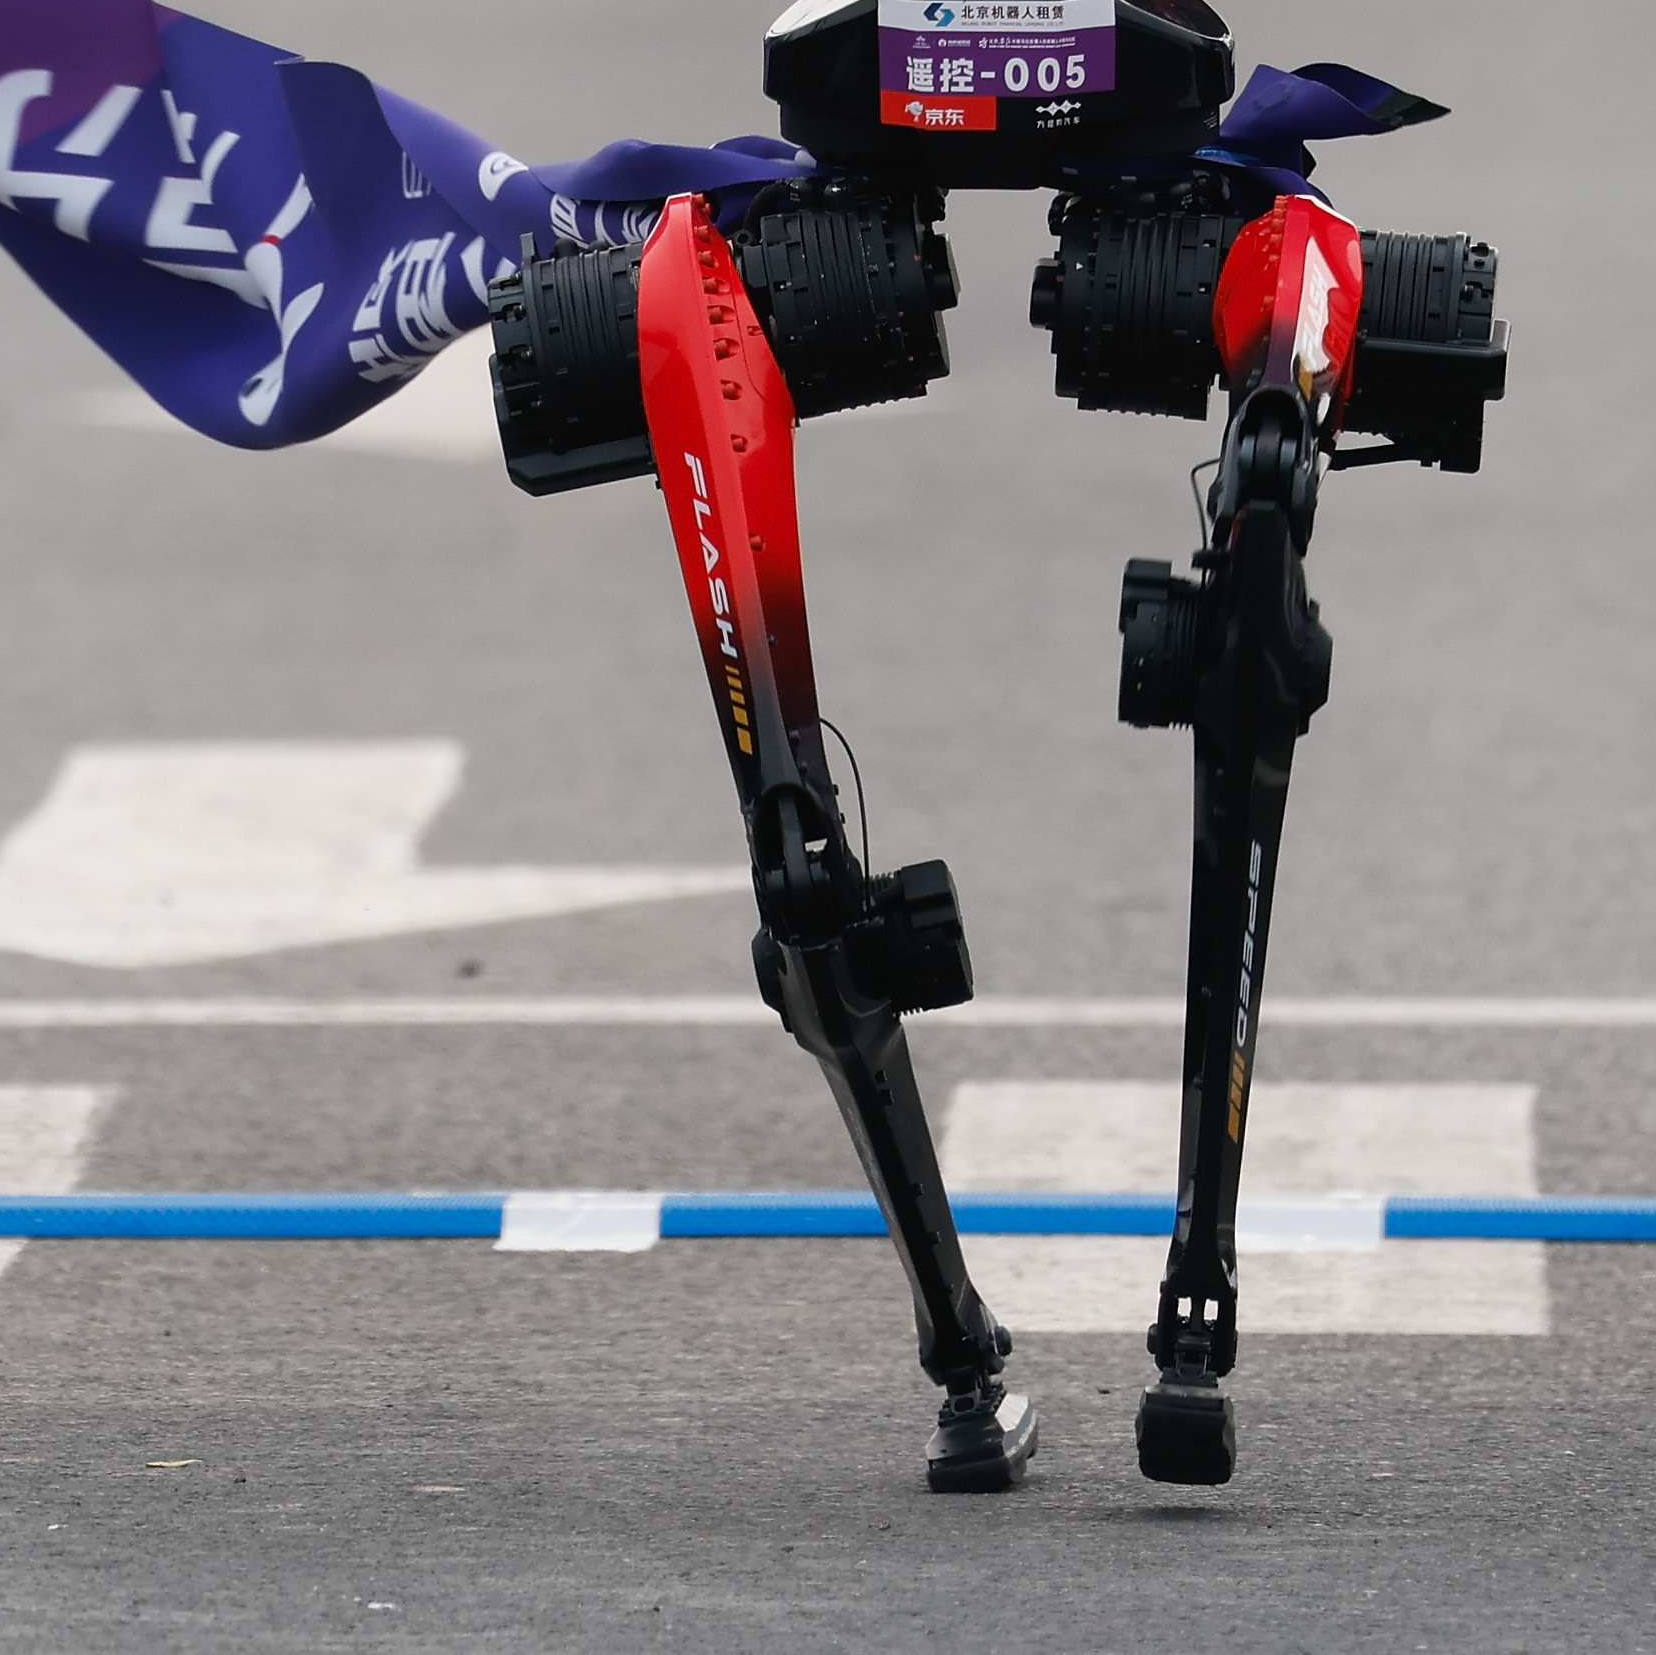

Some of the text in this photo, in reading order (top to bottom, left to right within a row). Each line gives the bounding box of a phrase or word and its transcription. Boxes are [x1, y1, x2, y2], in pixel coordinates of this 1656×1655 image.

[961, 5, 1065, 20] 北京机器人租赁
[905, 53, 1086, 93] 遥控-005
[925, 108, 965, 126] 京东
[683, 451, 738, 659] FLASH
[1236, 838, 1263, 1049] SPEED
